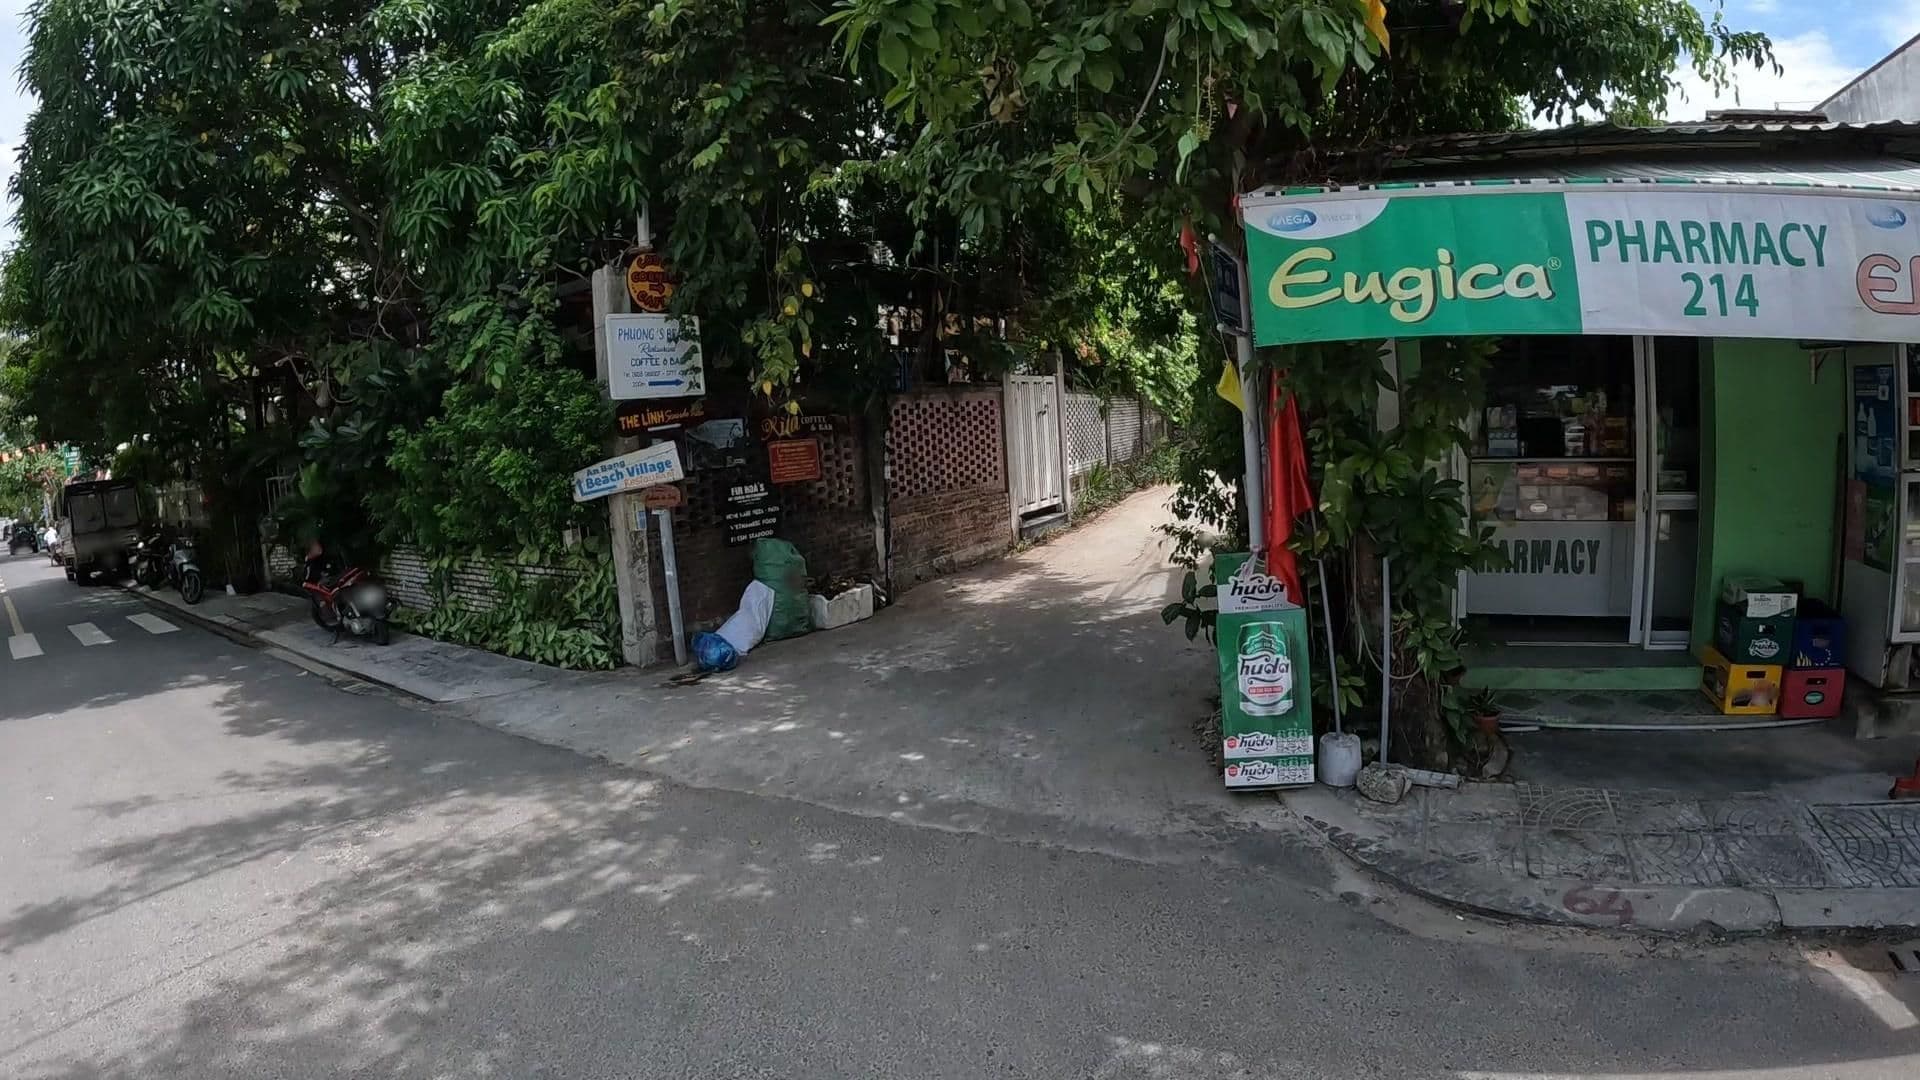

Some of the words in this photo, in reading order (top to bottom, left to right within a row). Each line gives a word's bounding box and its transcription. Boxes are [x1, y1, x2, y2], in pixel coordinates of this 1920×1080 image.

[1271, 213, 1312, 225] MEGA
[1585, 220, 1827, 267] PHARMACY
[1681, 272, 1759, 317] 214
[619, 414, 640, 430] THE
[585, 469, 624, 489] Beach
[626, 458, 673, 477] Village
[587, 467, 600, 477] An
[600, 459, 626, 472] Bang
[748, 529, 774, 540] SEAFOOD
[1231, 576, 1285, 598] huda
[1240, 655, 1289, 676] huda
[1239, 733, 1274, 748] huda
[1240, 763, 1275, 777] huda
